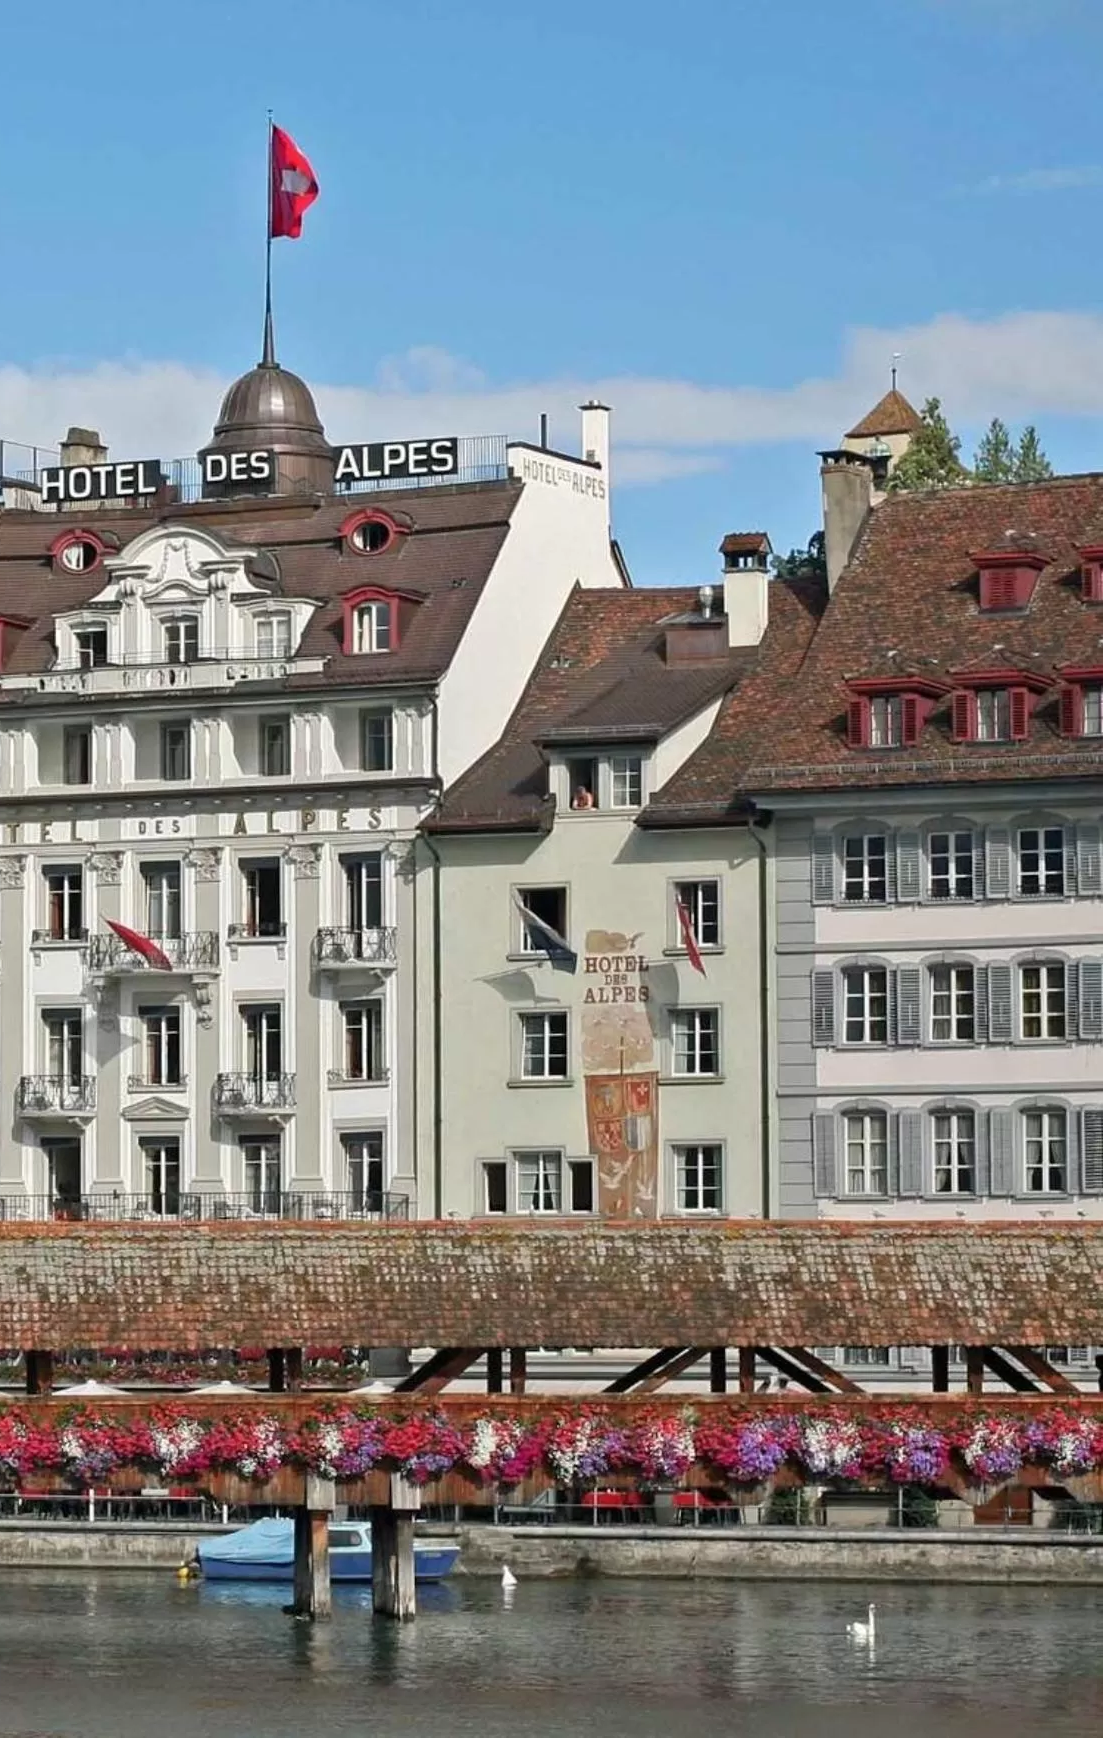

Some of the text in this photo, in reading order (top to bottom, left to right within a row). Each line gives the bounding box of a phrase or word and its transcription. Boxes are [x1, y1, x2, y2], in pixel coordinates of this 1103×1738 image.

[42, 440, 455, 500] HOTEL DES ALPES
[522, 457, 606, 500] HOTEL DES ALPES
[138, 819, 181, 835] DES
[233, 805, 382, 836] ALPES
[584, 955, 649, 974] HOTEL
[603, 974, 628, 986] DES
[583, 985, 650, 1004] ALPES
